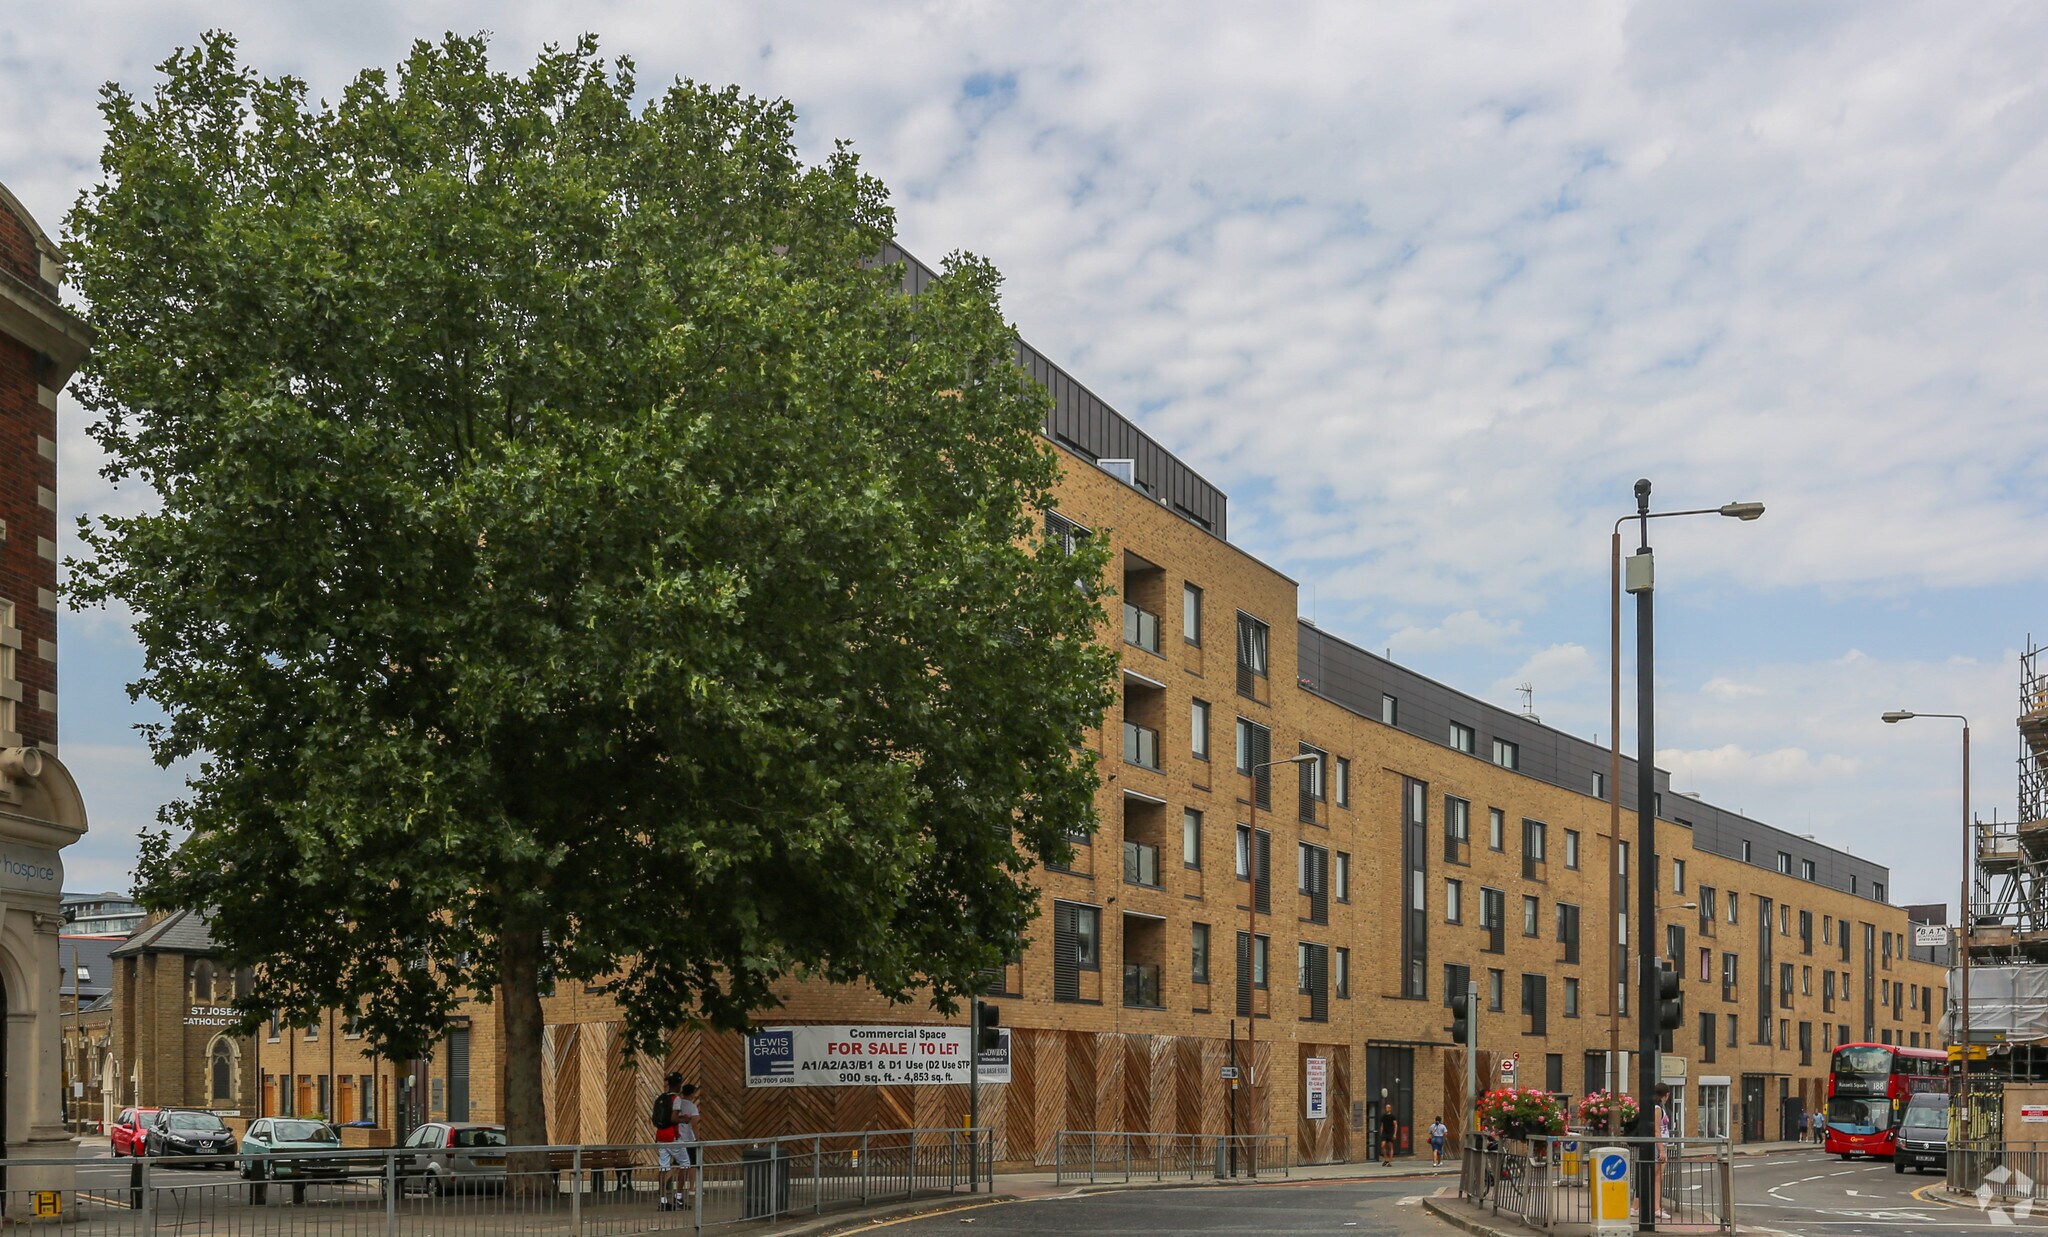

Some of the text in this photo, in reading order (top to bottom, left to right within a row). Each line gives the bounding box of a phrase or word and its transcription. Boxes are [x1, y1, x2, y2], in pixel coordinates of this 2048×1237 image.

[3, 853, 54, 881] hospice
[191, 1006, 206, 1015] ST.
[849, 1029, 947, 1041] Commercial Space
[753, 1037, 789, 1047] LEWIS
[753, 1047, 789, 1056] CRAIG
[827, 1042, 959, 1055] FOR SALE / TO LET
[801, 1060, 873, 1071] A1/A2/A3/B1
[877, 1060, 886, 1070] &
[889, 1060, 902, 1070] D1
[905, 1060, 924, 1070] Use
[925, 1060, 940, 1071] (D2
[941, 1061, 956, 1070] Use
[839, 1072, 861, 1082] 900
[864, 1073, 883, 1084] sq.
[883, 1072, 895, 1082] ft.
[903, 1072, 929, 1083] 4,853
[931, 1074, 944, 1083] sq.
[945, 1072, 953, 1081] ft.
[1873, 1082, 1884, 1090] 188
